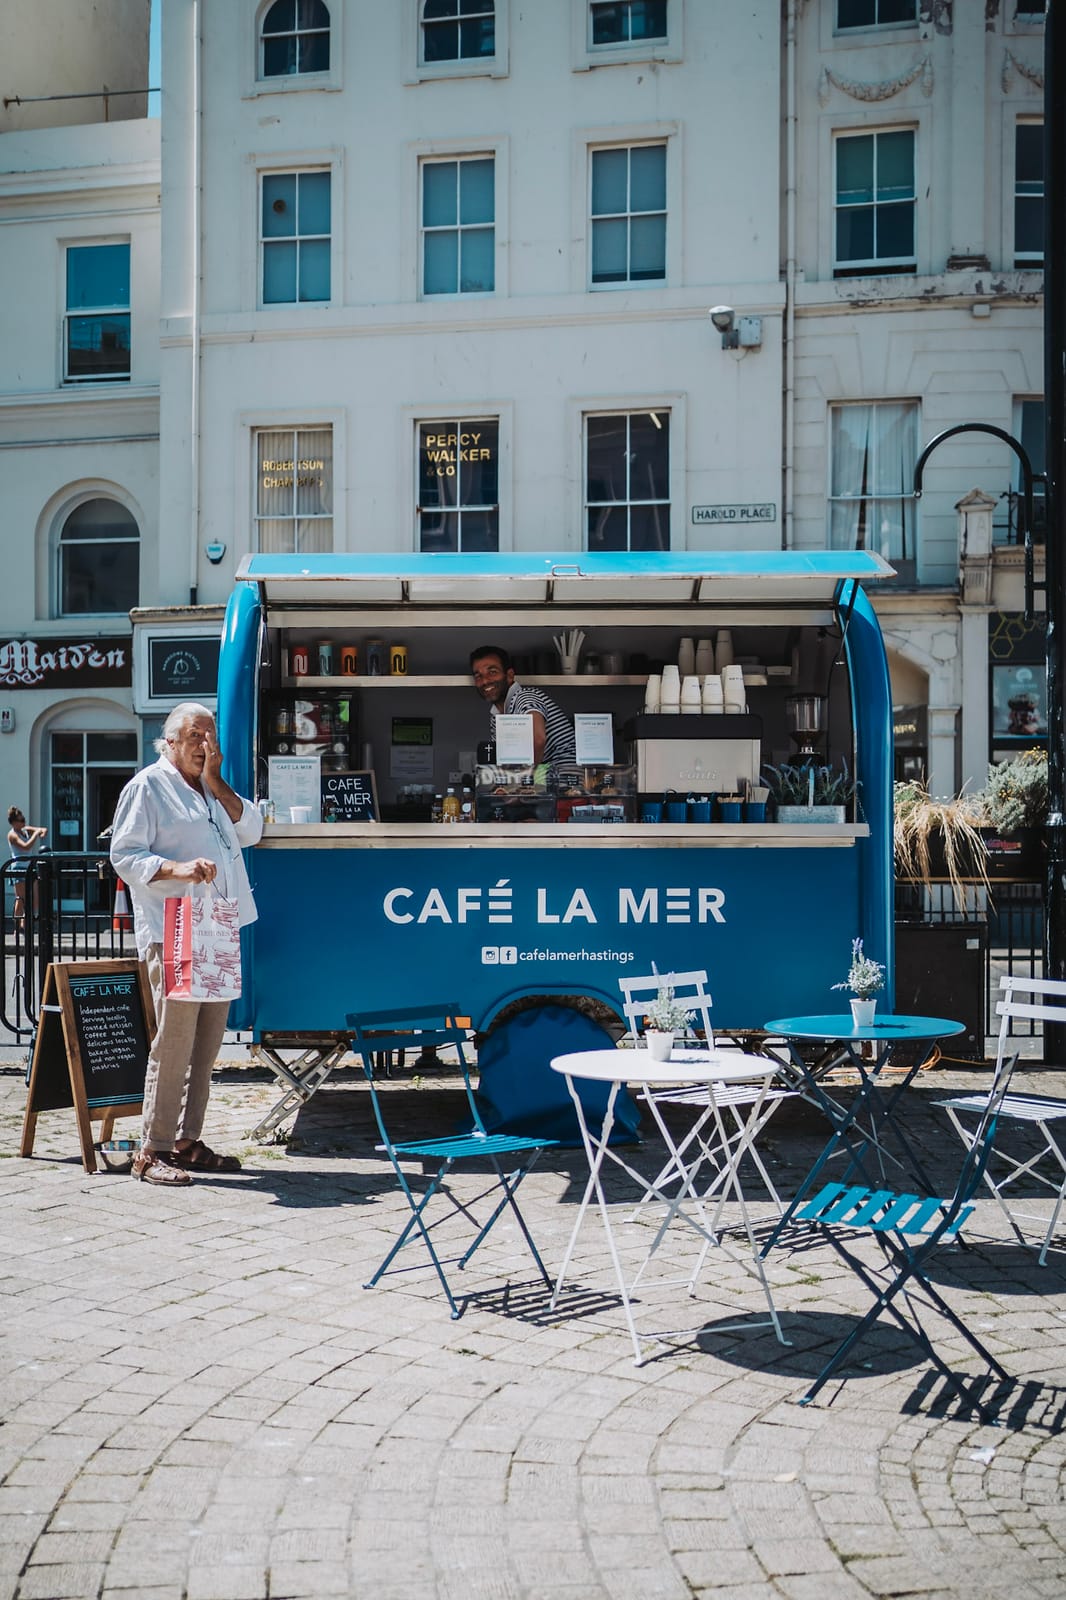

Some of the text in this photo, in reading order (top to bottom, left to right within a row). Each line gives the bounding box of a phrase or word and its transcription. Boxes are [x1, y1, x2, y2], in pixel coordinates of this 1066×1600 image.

[426, 433, 481, 447] PERCY
[427, 448, 490, 462] WALKER
[263, 460, 324, 471] ROBERTSON
[740, 507, 771, 518] PLACE
[0, 640, 125, 684] Maiden
[327, 778, 363, 791] CAFE
[343, 792, 372, 805] MER
[383, 879, 726, 924] CAFÉ LA MER
[173, 904, 185, 987] WATERSTONES
[519, 949, 634, 964] cafelamerhastings
[99, 985, 112, 996] LA
[113, 984, 132, 995] MER
[86, 1039, 114, 1047] delicious
[88, 1048, 109, 1057] baked
[117, 1053, 136, 1061] vegan
